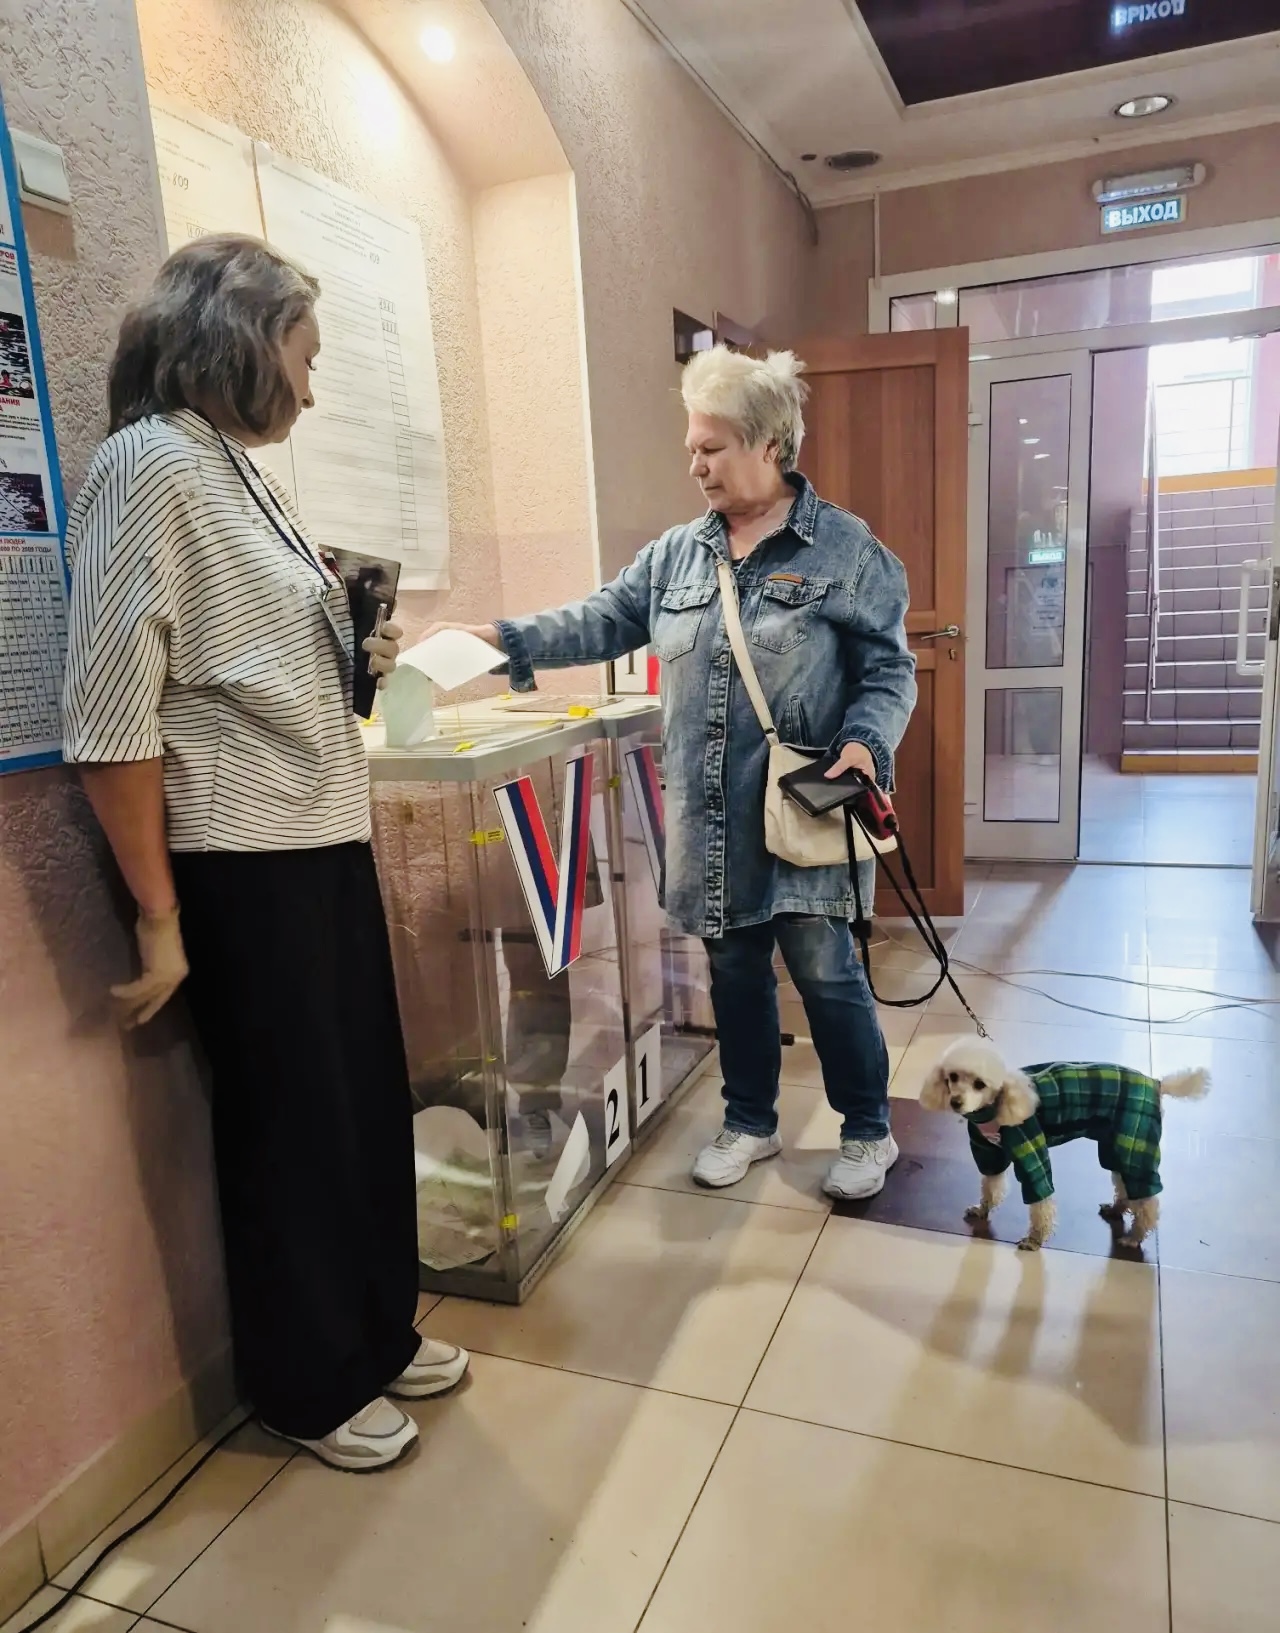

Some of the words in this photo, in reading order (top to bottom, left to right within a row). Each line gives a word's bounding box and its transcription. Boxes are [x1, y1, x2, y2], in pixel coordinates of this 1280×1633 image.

[1108, 200, 1179, 228] ВЫХОД
[638, 1052, 650, 1108] 1
[606, 1088, 620, 1149] 2
